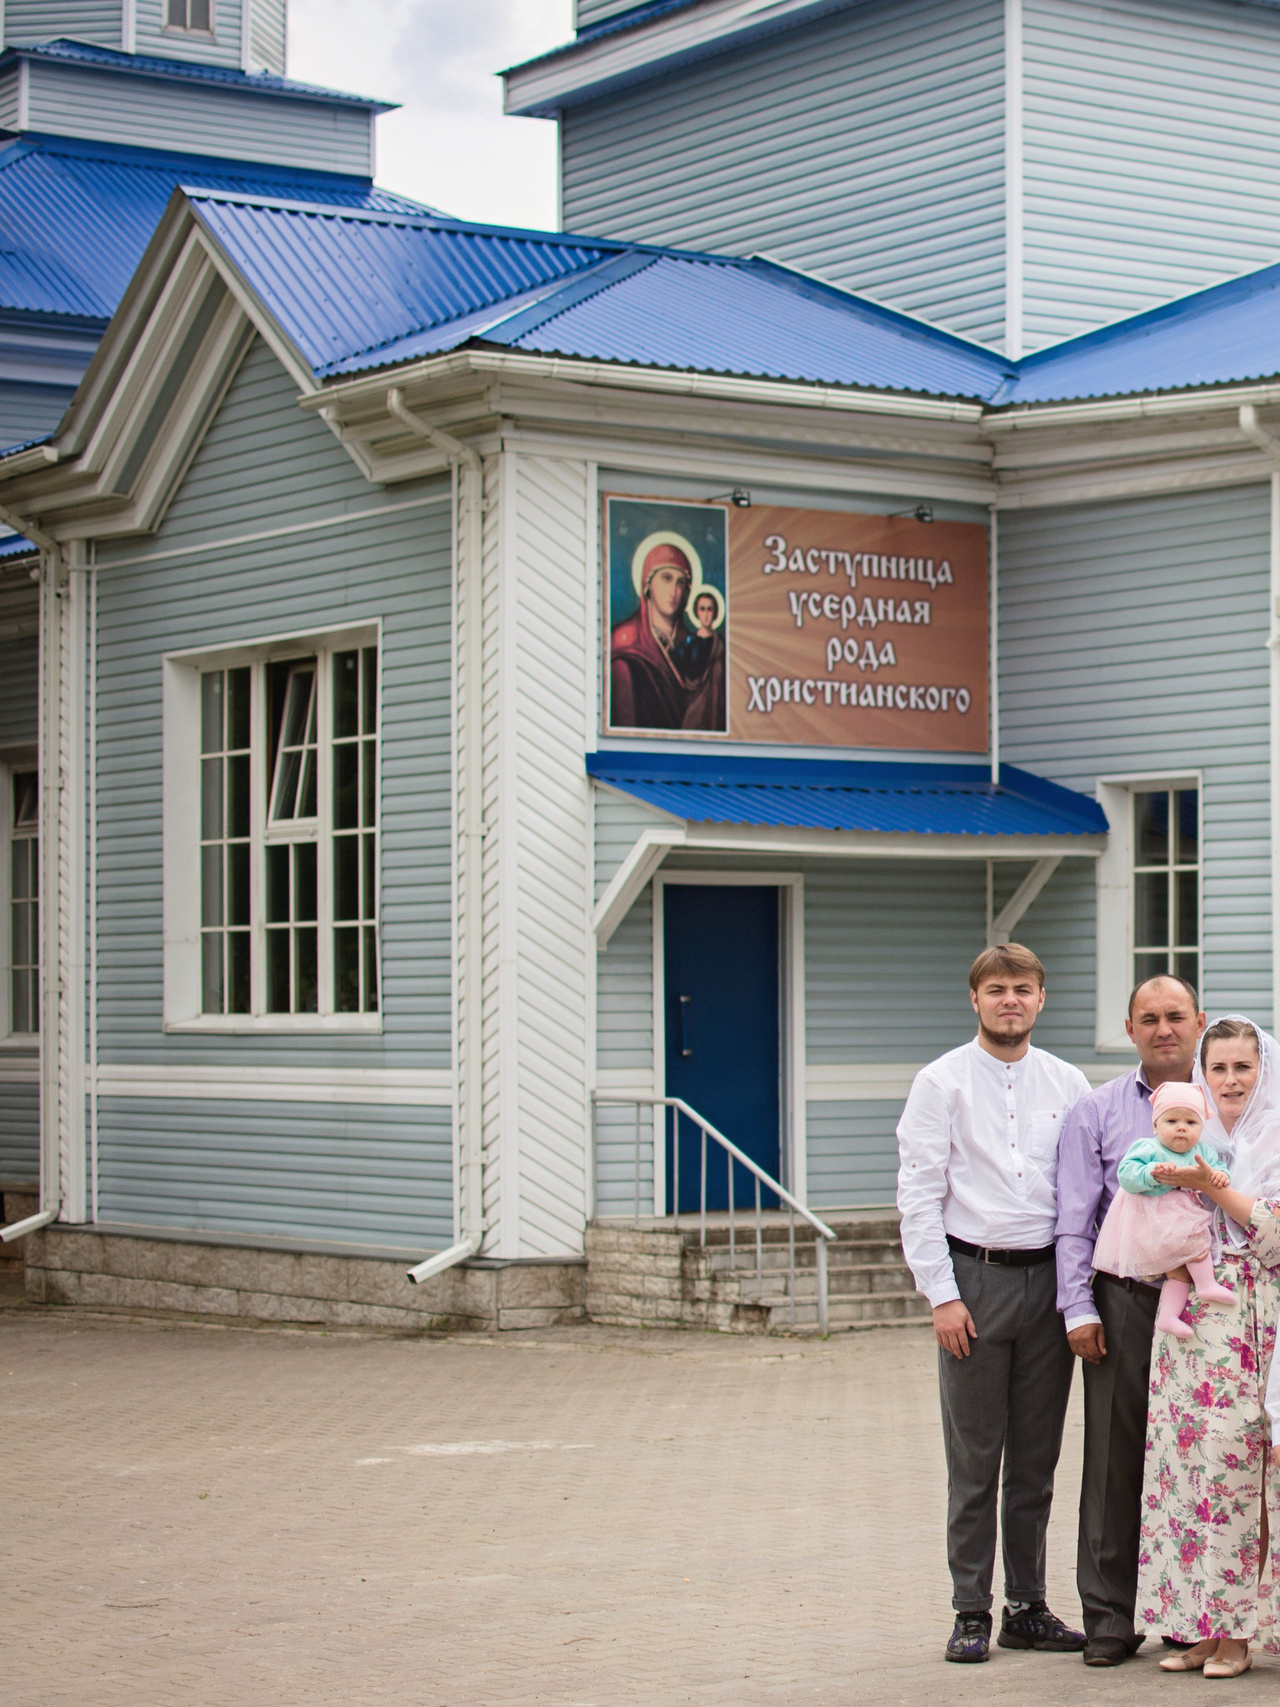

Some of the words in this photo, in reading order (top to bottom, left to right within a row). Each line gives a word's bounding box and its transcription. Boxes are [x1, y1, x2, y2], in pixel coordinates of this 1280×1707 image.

[763, 535, 953, 590] Заступница
[789, 591, 930, 630] усердная
[826, 637, 896, 672] рода
[747, 676, 971, 713] христианского
